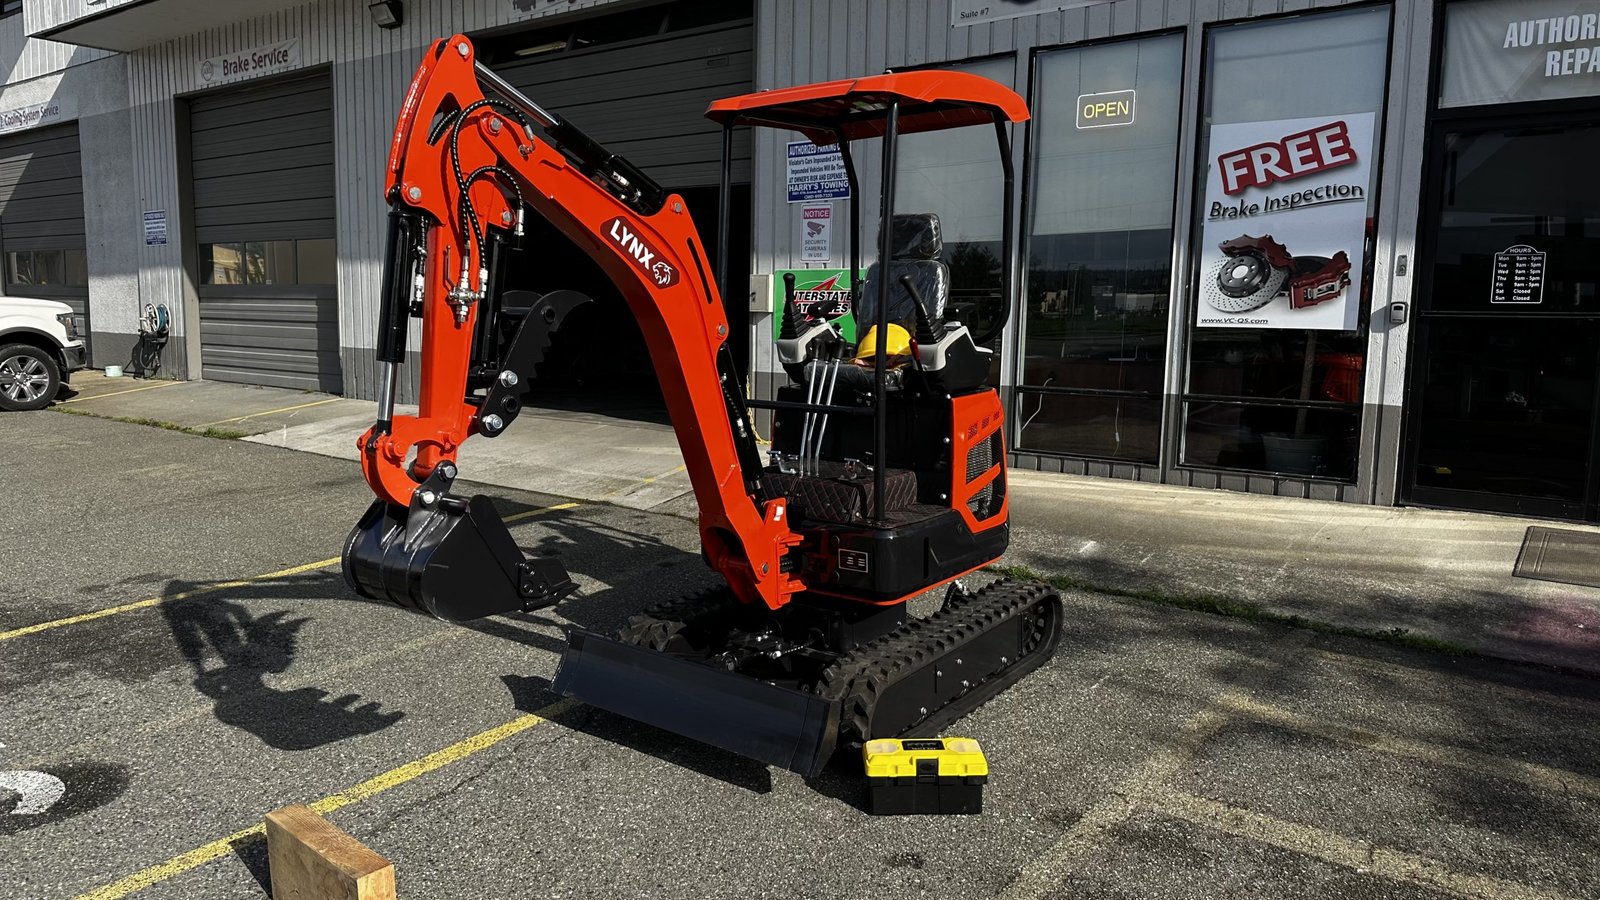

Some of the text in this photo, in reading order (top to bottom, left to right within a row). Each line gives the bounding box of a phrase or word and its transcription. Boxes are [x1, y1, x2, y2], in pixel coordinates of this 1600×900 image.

[960, 8, 990, 19] Suite #7
[223, 56, 249, 76] Brake
[252, 48, 288, 70] Service
[23, 110, 39, 125] System
[41, 104, 59, 119] Service
[1084, 100, 1129, 119] OPEN
[789, 143, 817, 156] AUTHORIZED
[1222, 126, 1350, 192] FREE
[789, 180, 849, 192] HARRY'S TOWING
[1210, 184, 1363, 218] Brake Inspection
[804, 210, 829, 218] NOTICE
[610, 219, 655, 270] LYNX
[793, 291, 852, 301] TERSTATE
